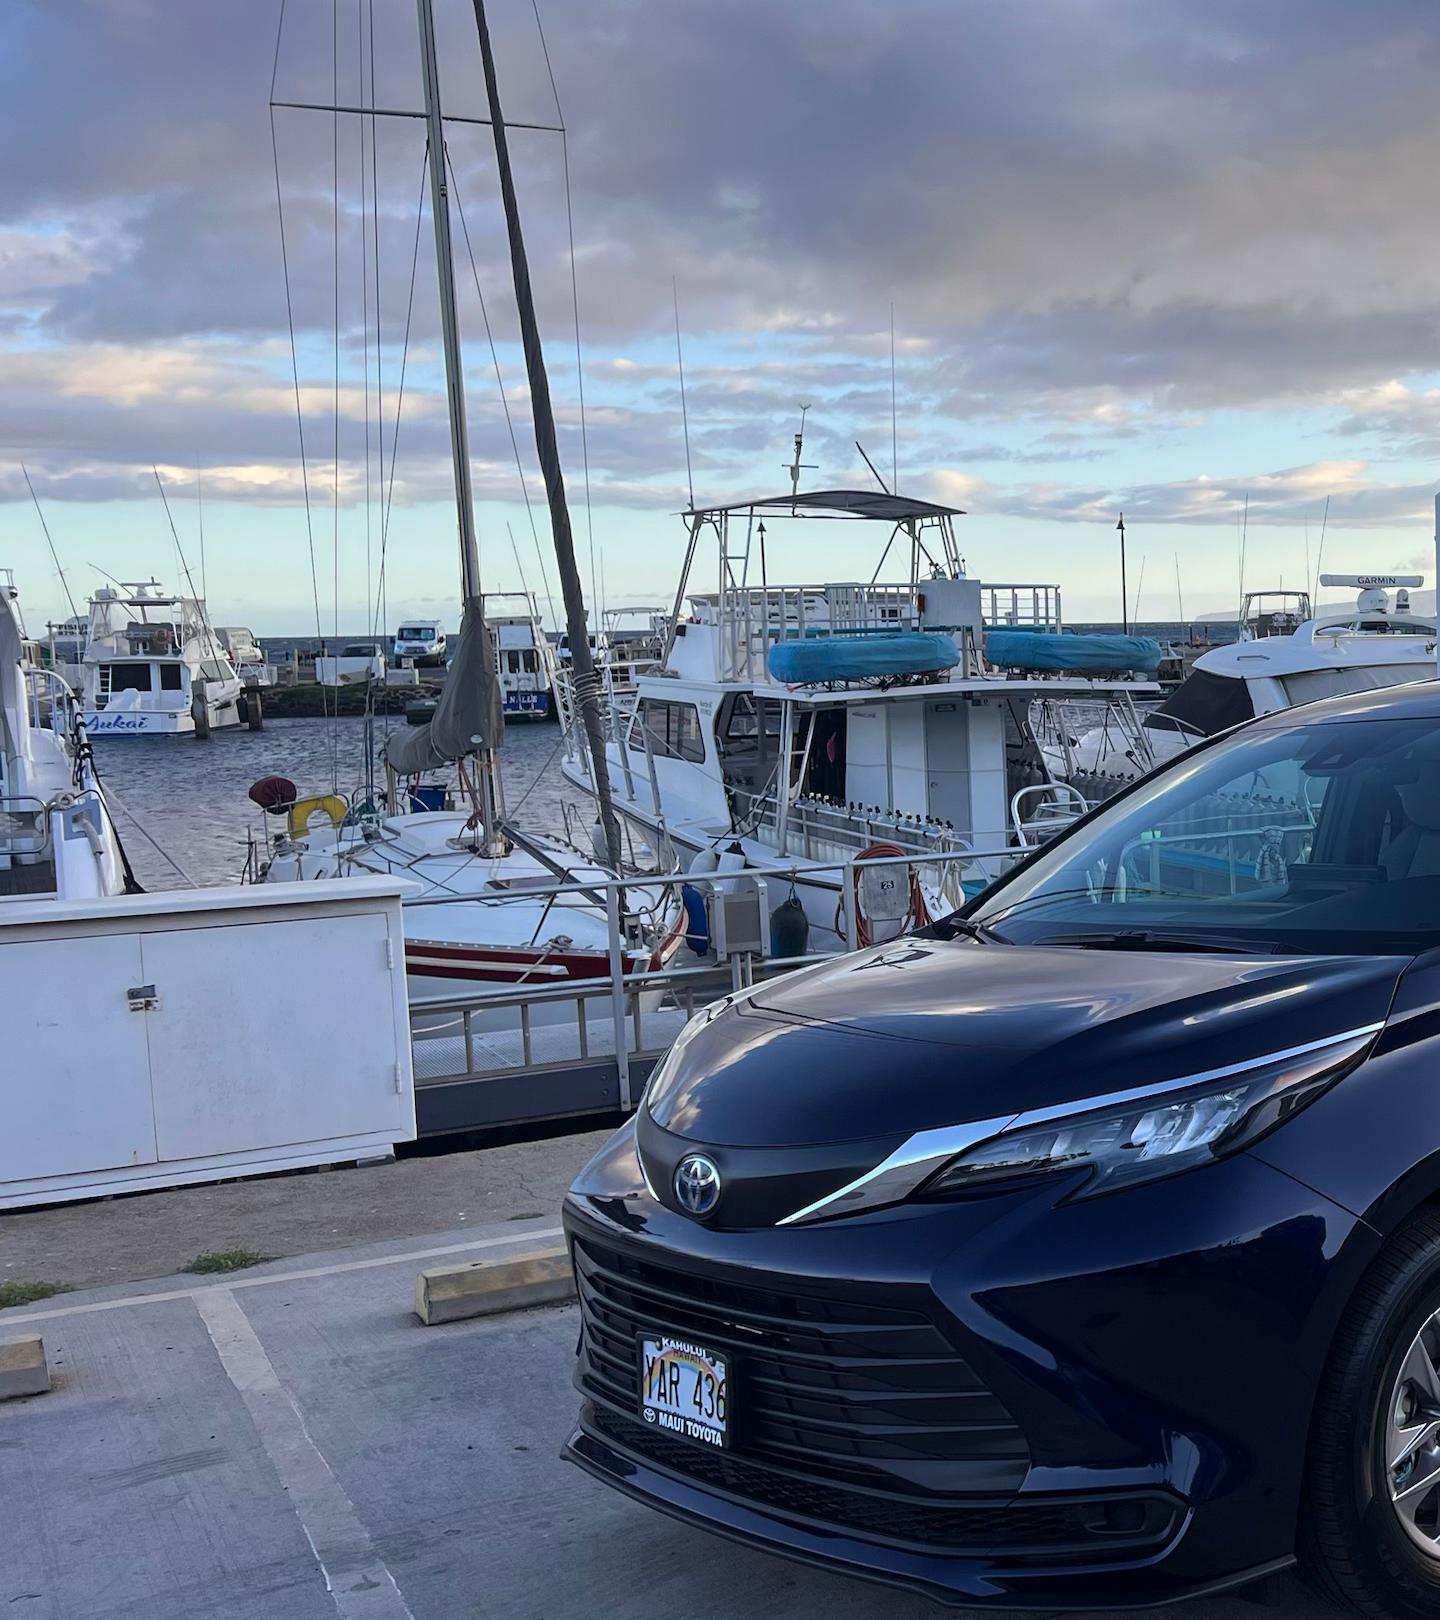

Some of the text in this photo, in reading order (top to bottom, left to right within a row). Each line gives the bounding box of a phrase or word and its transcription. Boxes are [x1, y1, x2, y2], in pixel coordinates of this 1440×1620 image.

[1357, 576, 1396, 585] GARMIN
[661, 1337, 706, 1358] KAHULUI
[645, 1353, 726, 1423] YAR 436
[658, 1412, 723, 1447] MAUI TOYOTA
